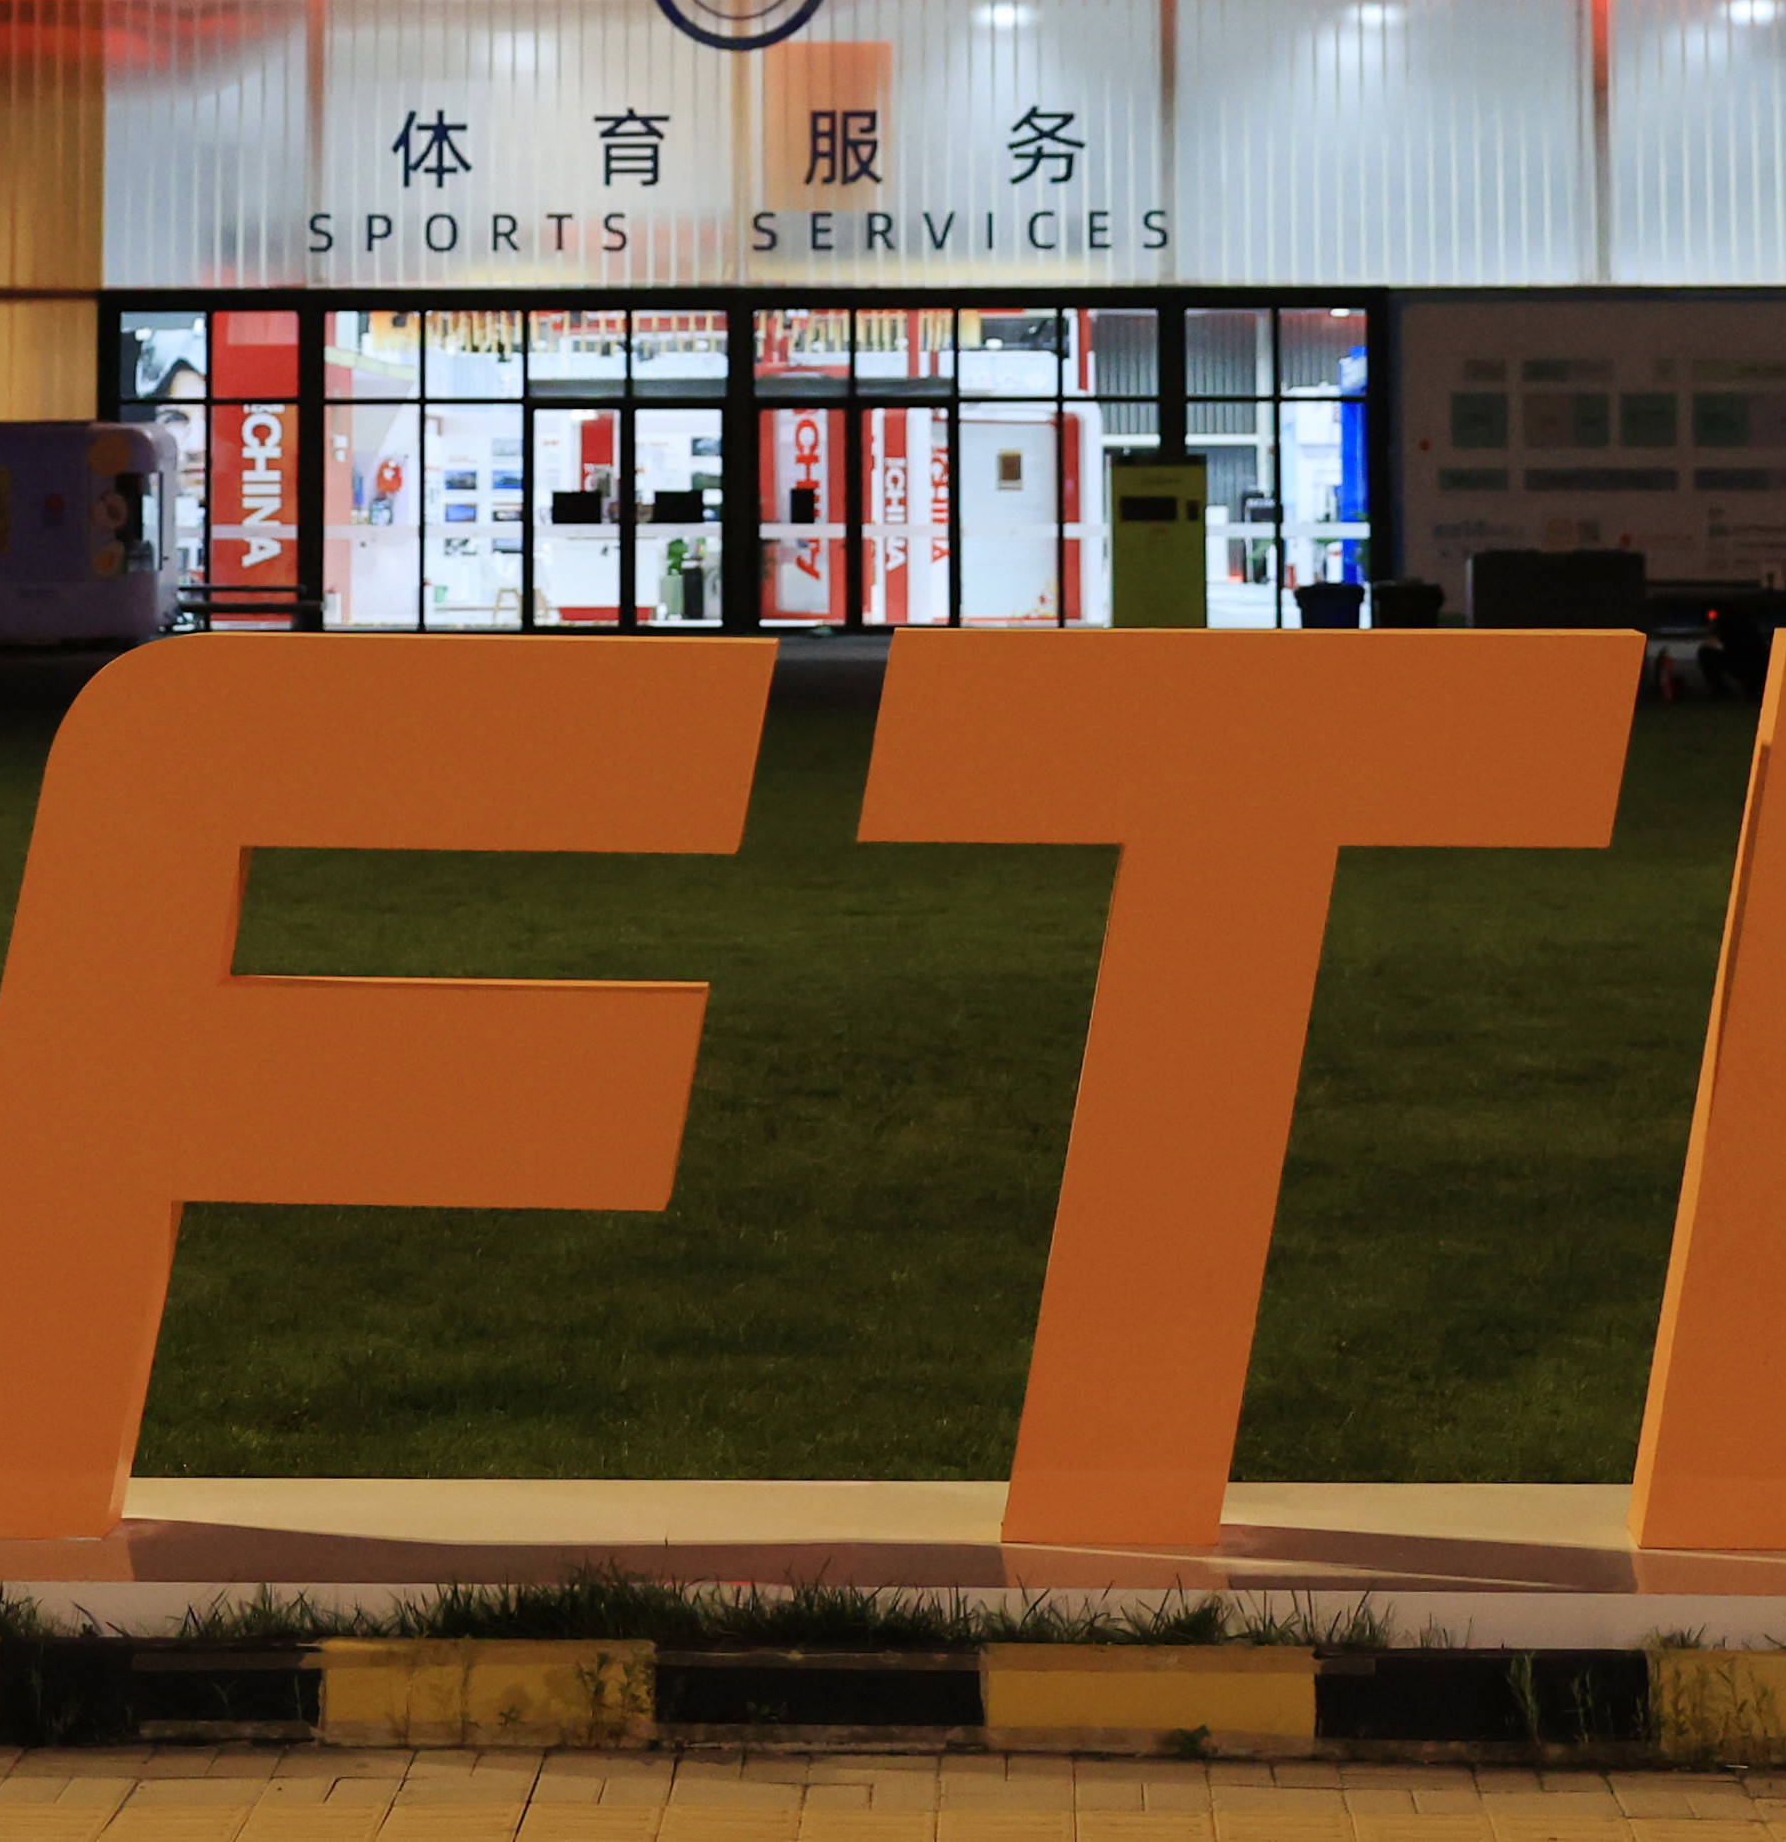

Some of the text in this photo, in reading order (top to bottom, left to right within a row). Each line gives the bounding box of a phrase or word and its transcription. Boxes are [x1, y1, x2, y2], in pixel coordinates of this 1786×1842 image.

[392, 107, 1086, 188] 体育服务
[308, 210, 1169, 254] SPORTS SERVICES
[241, 413, 284, 569] CHINA
